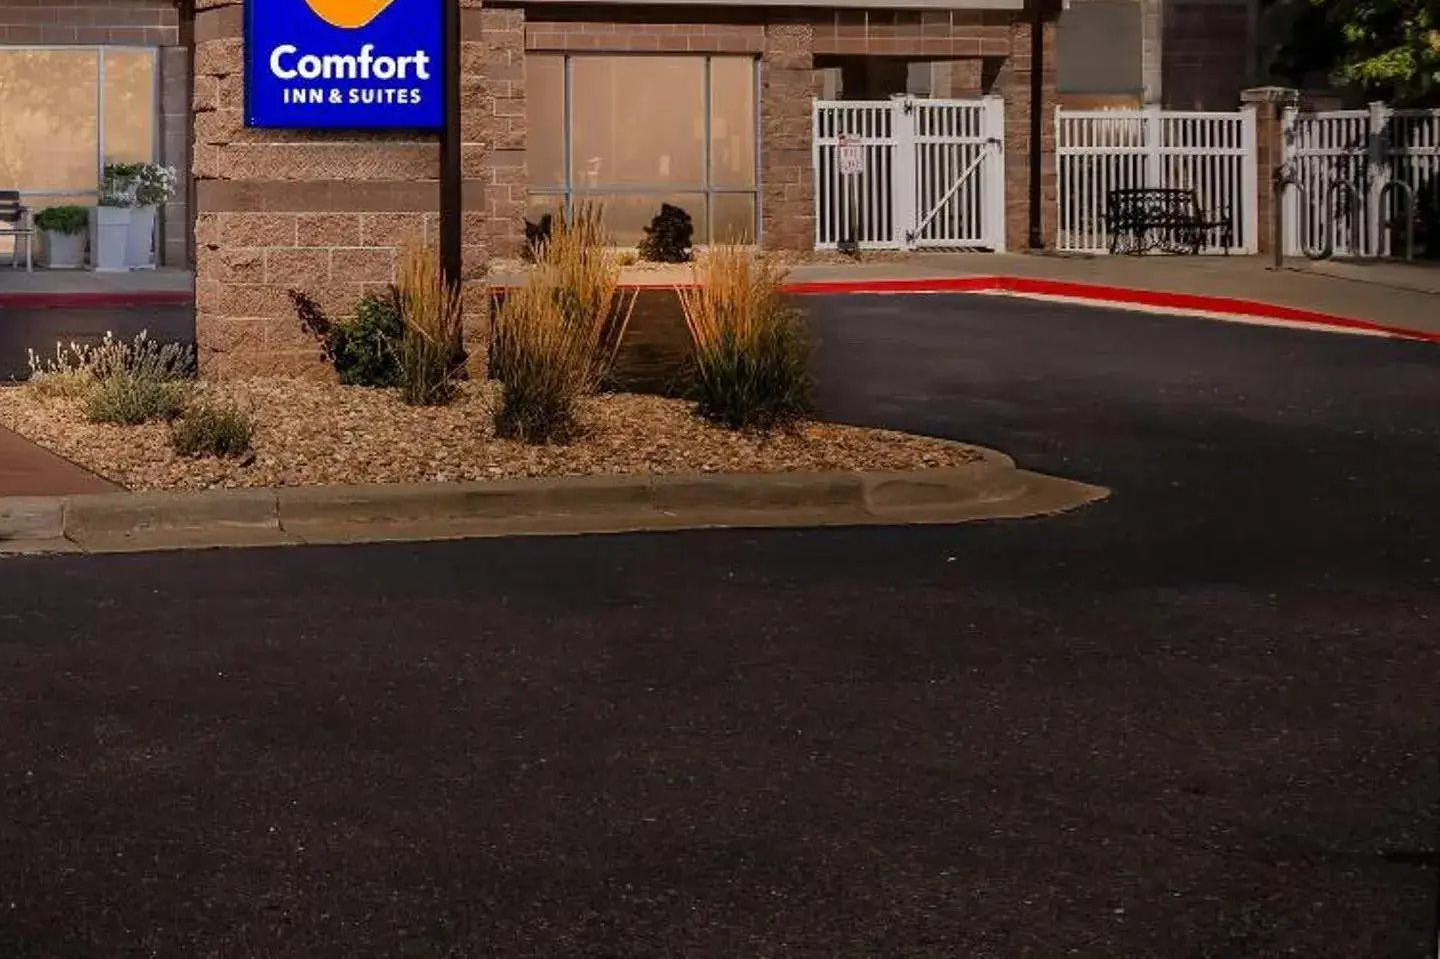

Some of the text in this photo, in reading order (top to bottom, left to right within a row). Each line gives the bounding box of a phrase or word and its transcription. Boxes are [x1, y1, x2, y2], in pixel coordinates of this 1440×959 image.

[269, 43, 430, 80] Comfort
[283, 88, 422, 104] INN & SUITES
